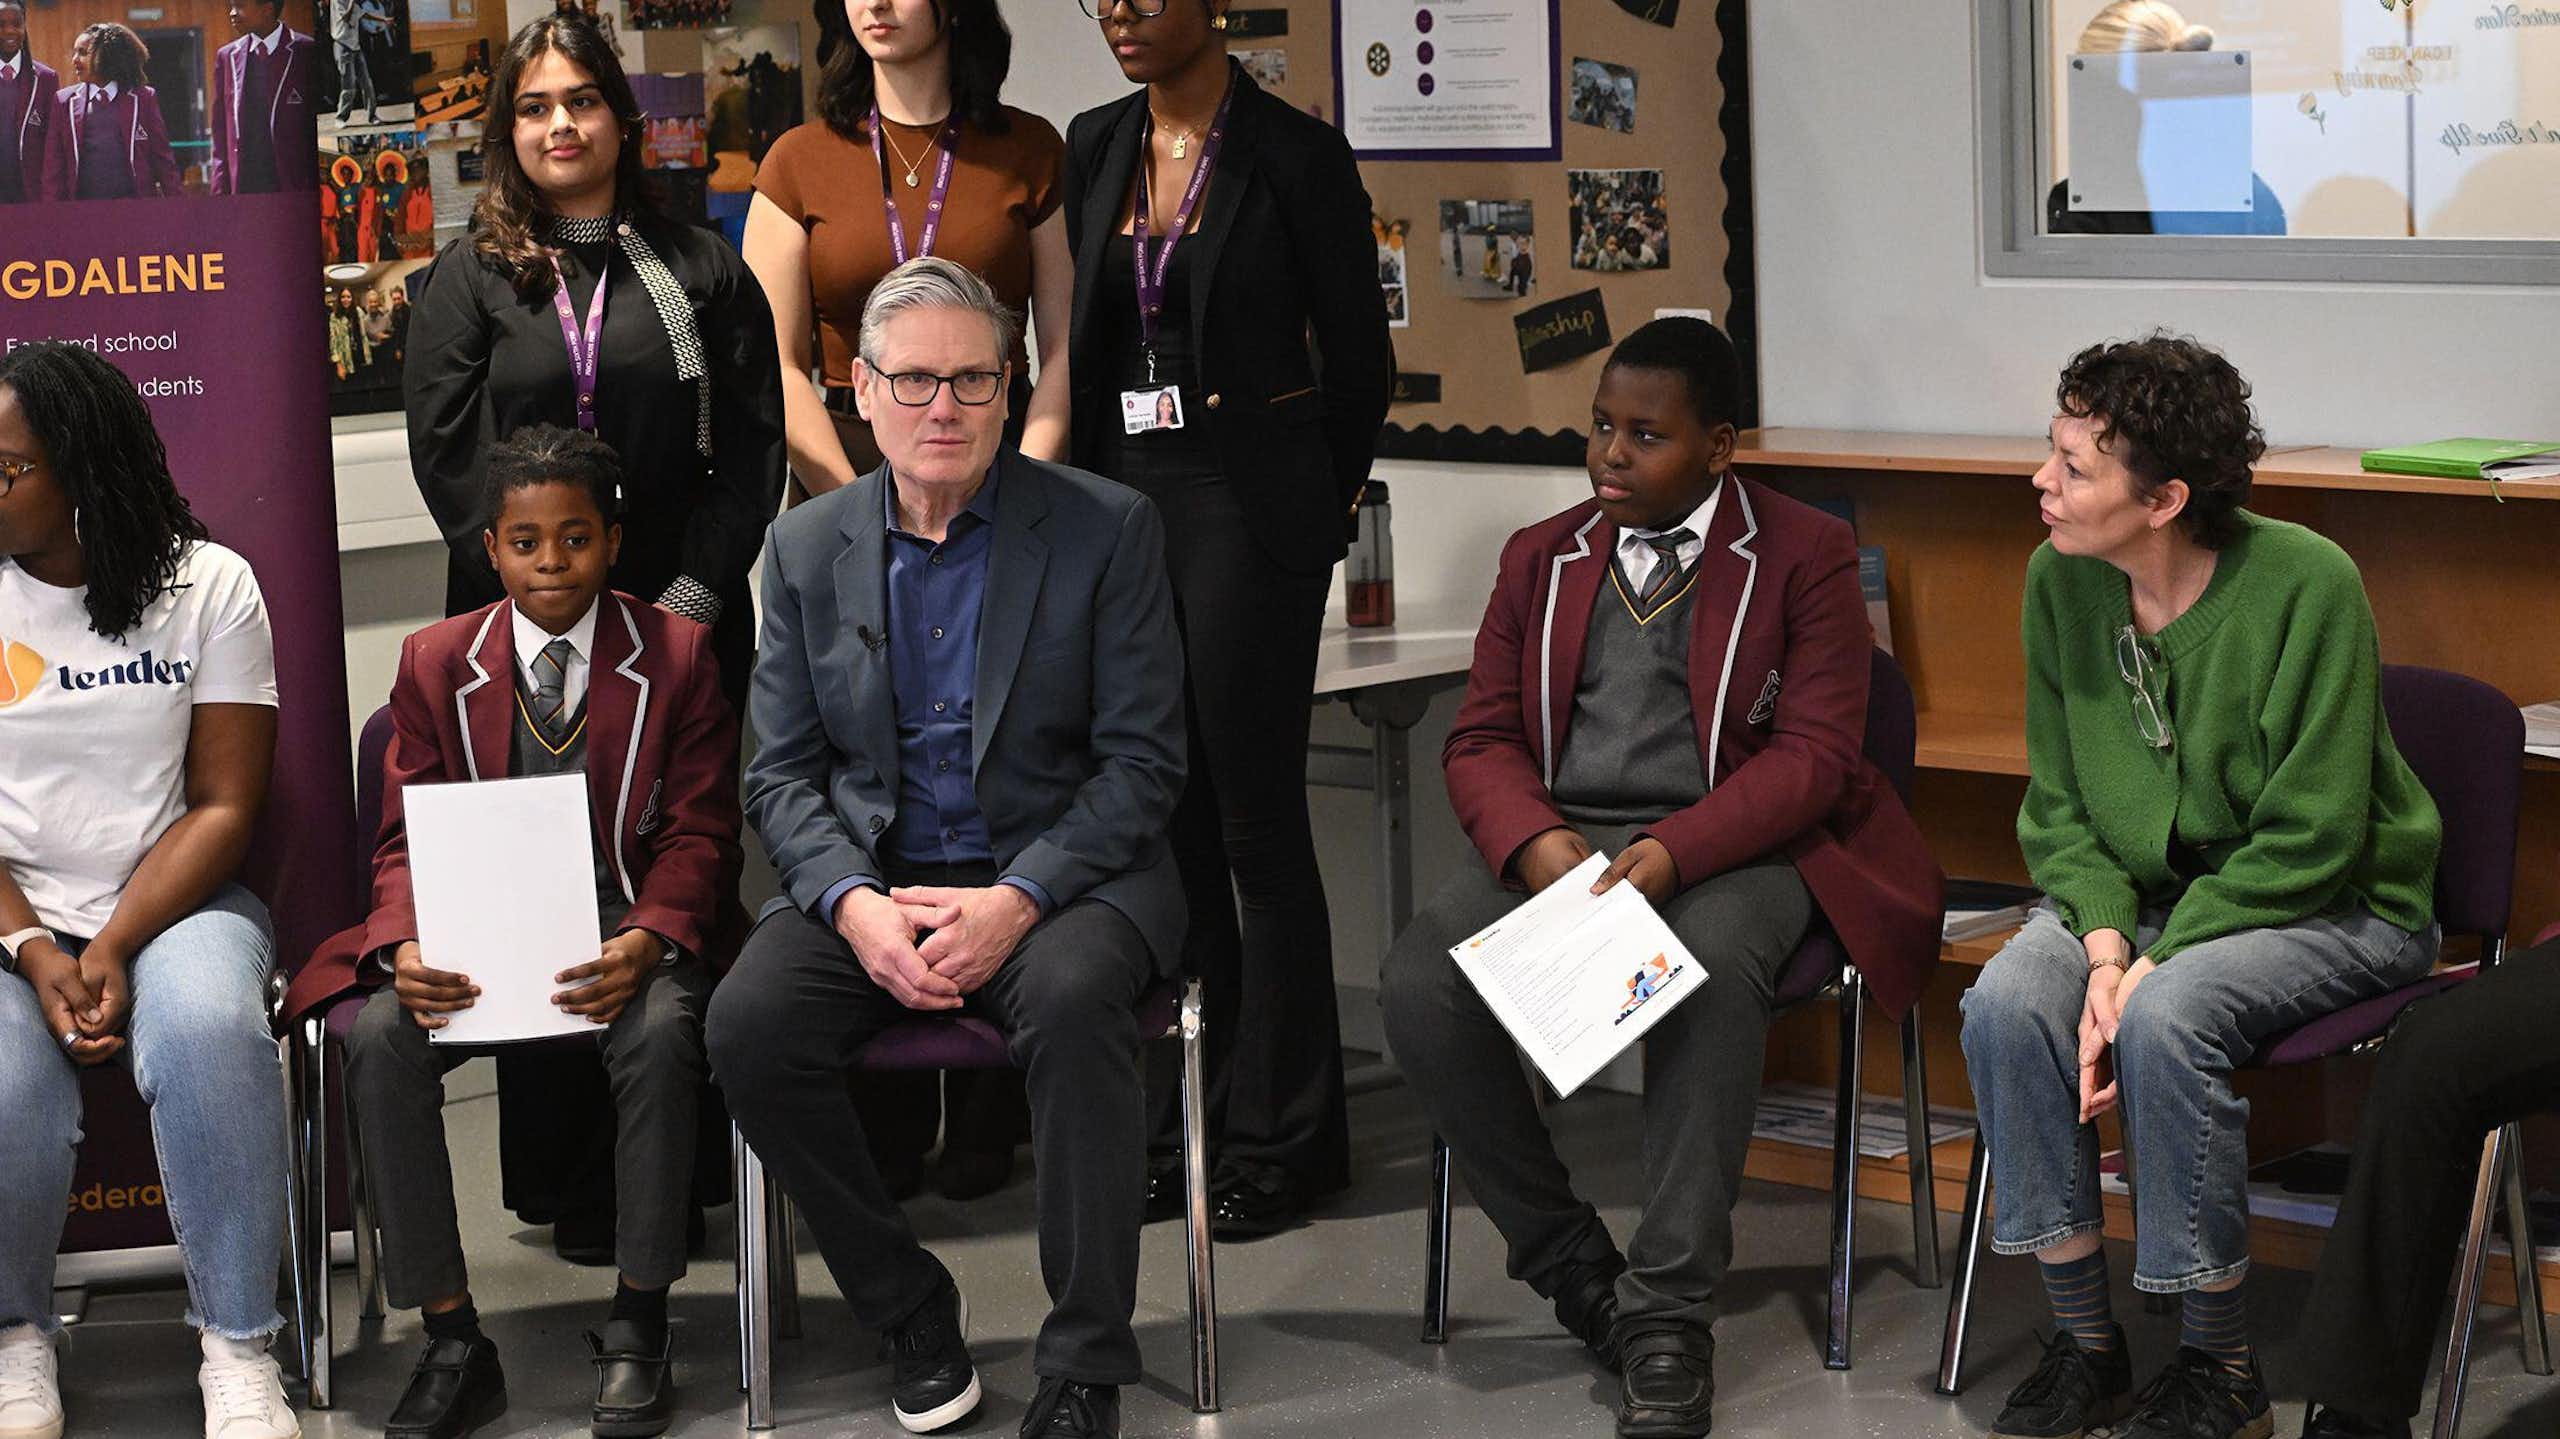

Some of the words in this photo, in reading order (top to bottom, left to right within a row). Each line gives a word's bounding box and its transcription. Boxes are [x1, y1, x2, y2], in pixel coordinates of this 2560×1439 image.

[1, 252, 225, 300] GDALENE
[104, 330, 177, 352] school
[57, 649, 193, 691] tender
